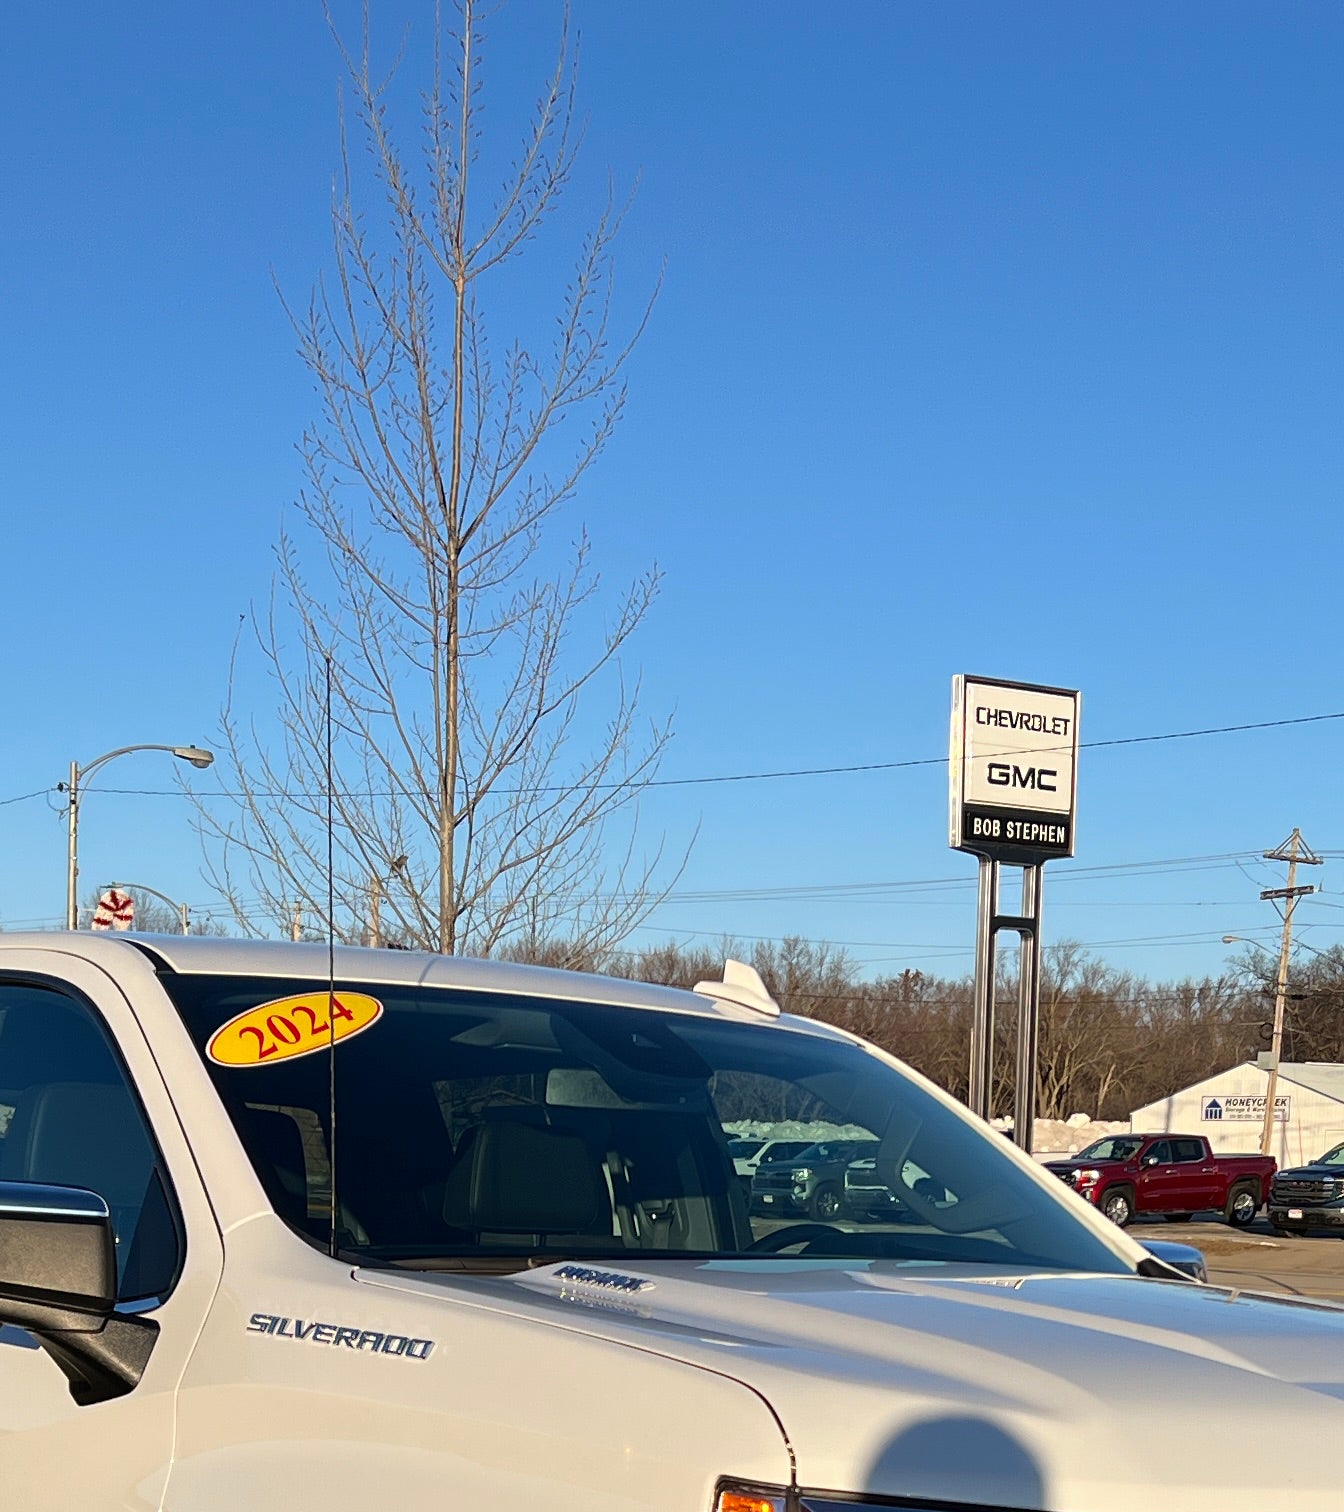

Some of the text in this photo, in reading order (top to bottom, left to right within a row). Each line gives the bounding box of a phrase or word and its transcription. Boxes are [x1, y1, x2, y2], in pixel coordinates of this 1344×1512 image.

[976, 706, 1071, 736] CHEVROLET
[987, 762, 1057, 792] GMC
[973, 817, 1065, 844] BOB STEPHEN
[239, 993, 354, 1060] 2024
[1225, 1098, 1287, 1107] HONEYCREK
[246, 1313, 434, 1360] SILVERADO
